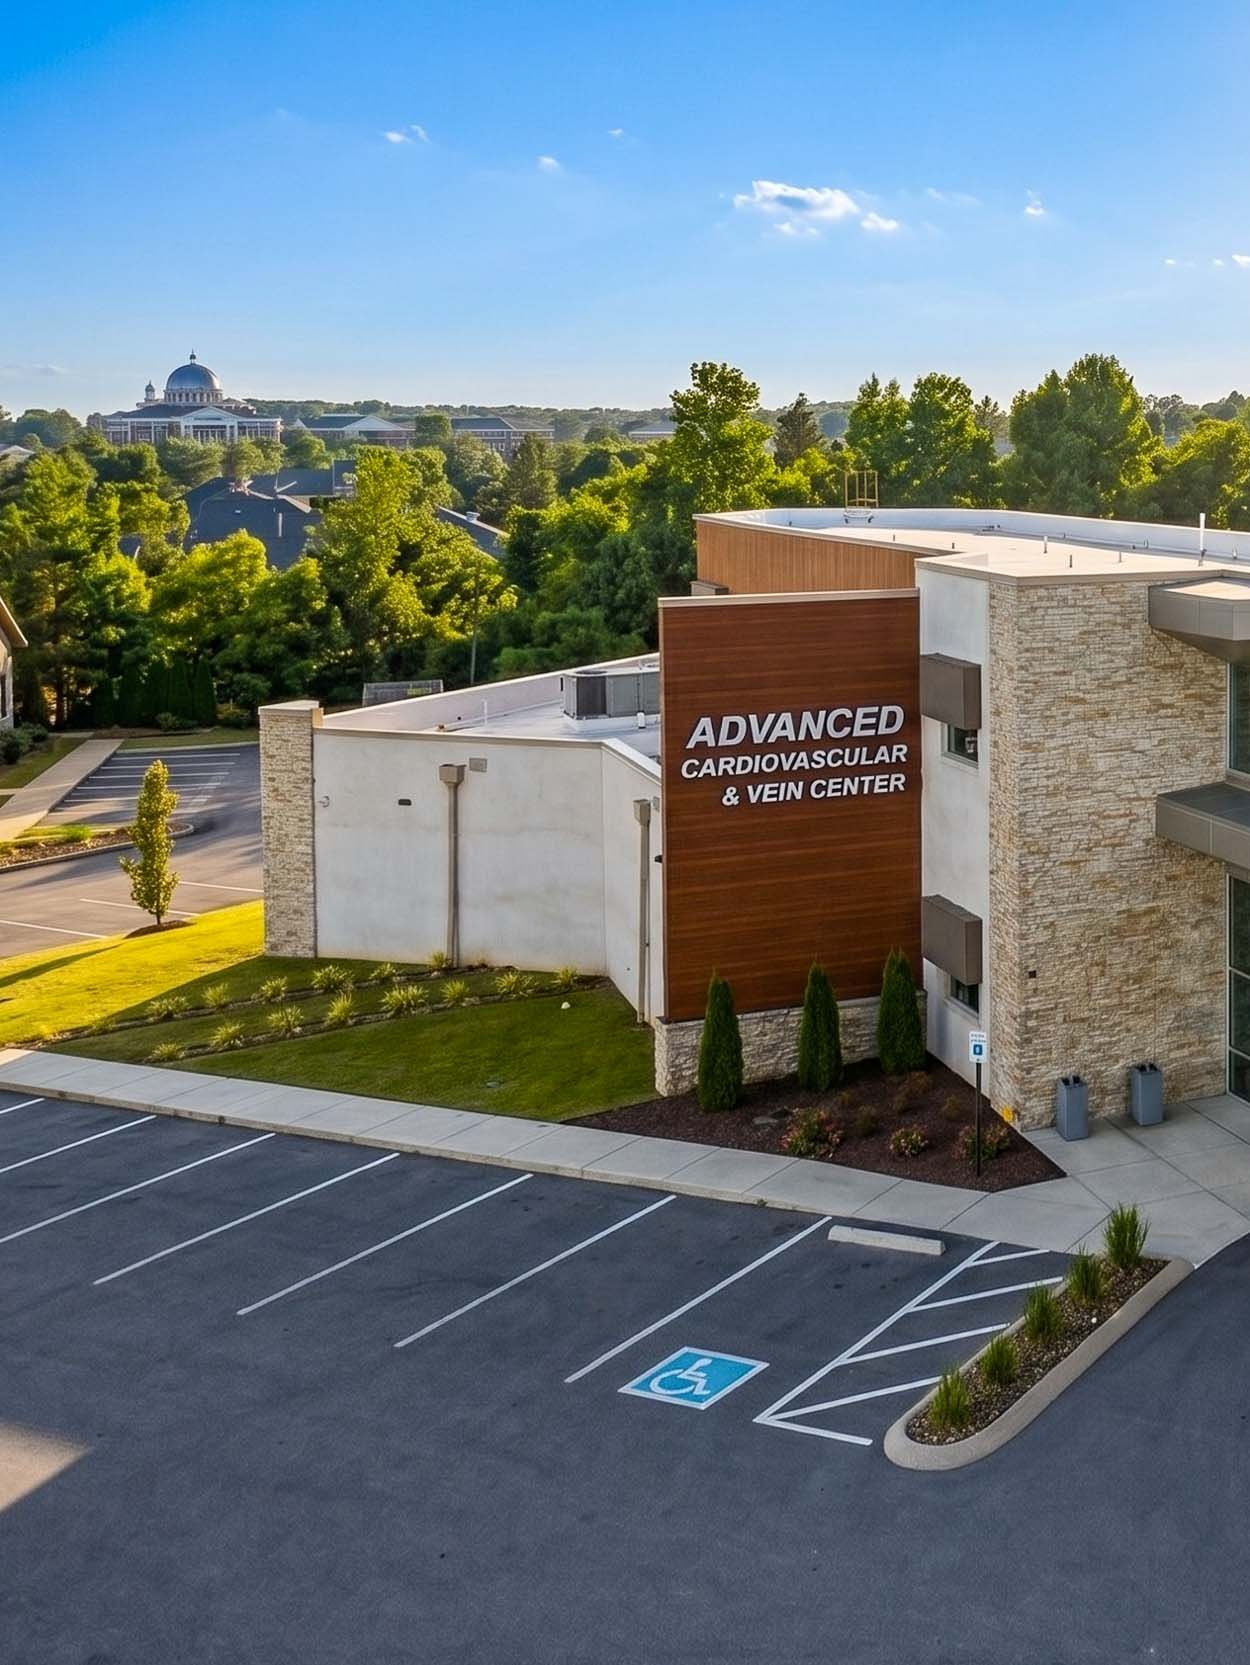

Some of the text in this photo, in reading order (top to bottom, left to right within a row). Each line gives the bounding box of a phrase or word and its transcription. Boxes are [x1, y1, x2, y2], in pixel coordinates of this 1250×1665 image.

[685, 705, 905, 749] ADVANCED
[681, 744, 908, 779] CARDIOVASCULAR
[721, 773, 906, 806] & VEIN CENTER
